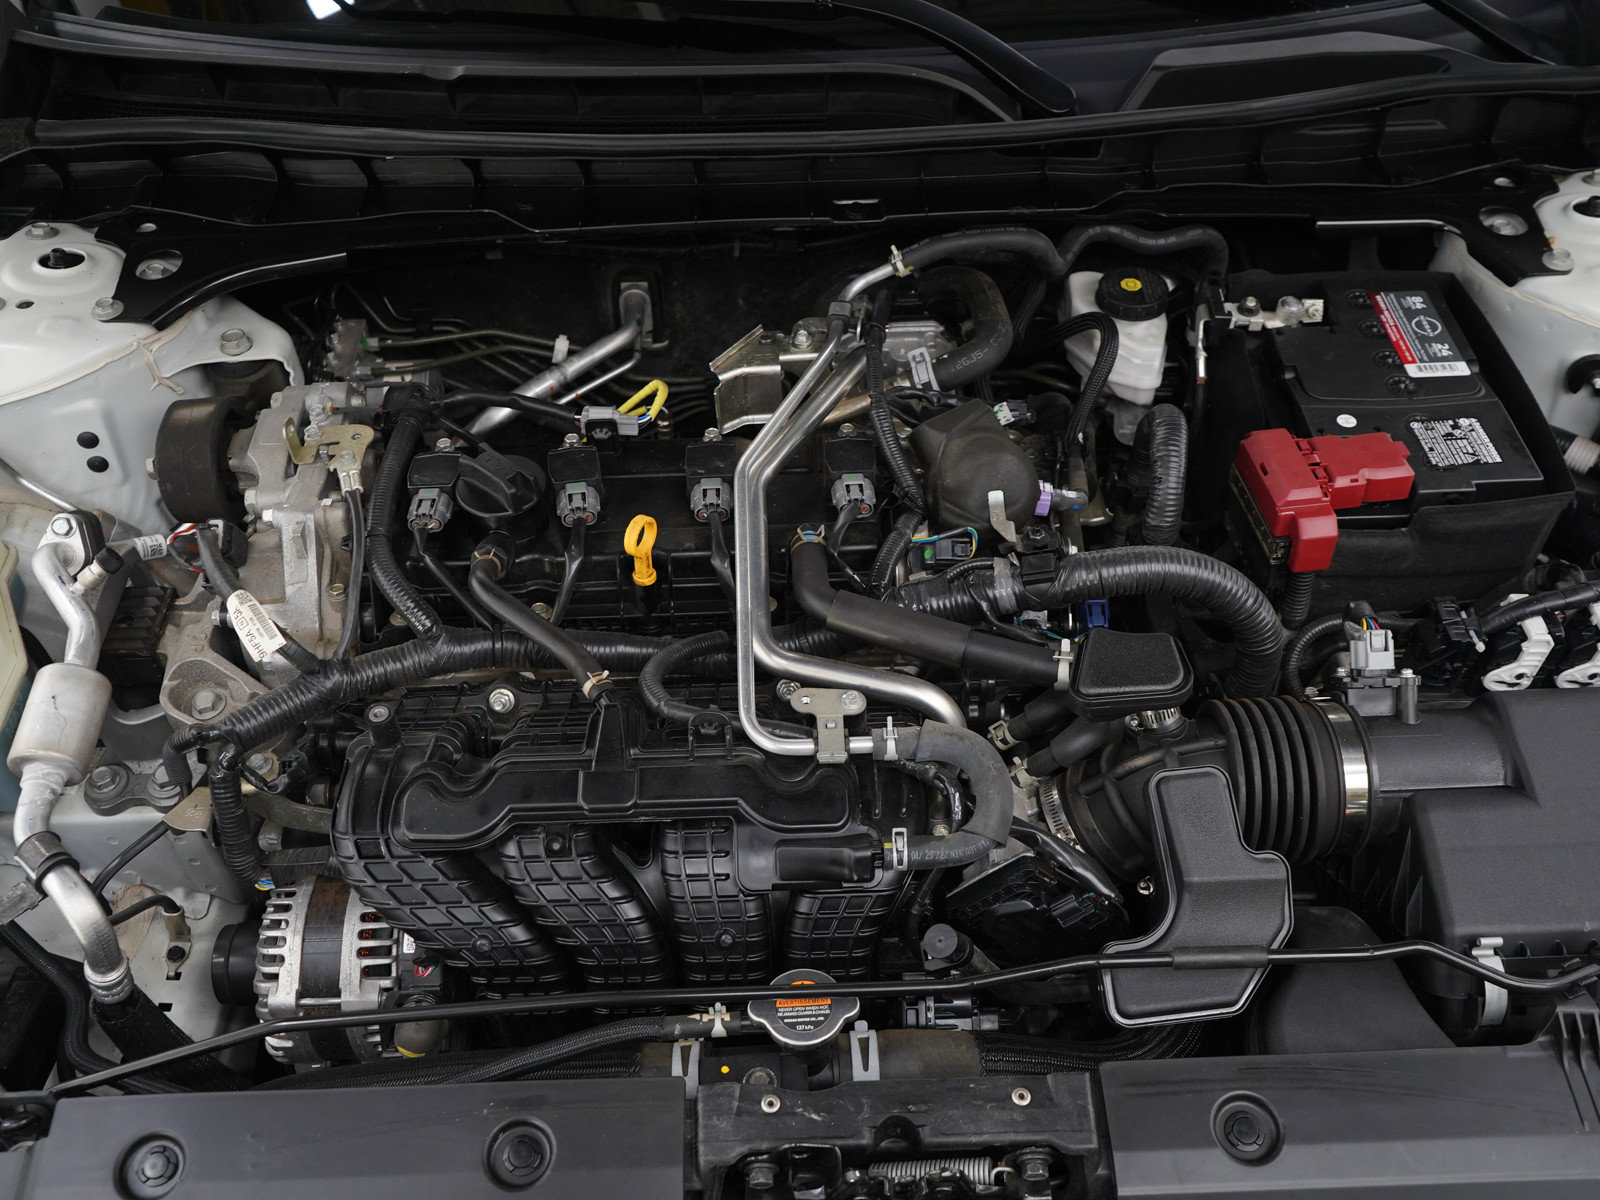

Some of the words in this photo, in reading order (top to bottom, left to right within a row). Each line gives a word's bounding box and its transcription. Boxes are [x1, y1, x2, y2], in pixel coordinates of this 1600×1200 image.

[1411, 296, 1427, 310] 84
[1419, 315, 1435, 337] NISSAN
[1438, 343, 1454, 357] 24
[245, 629, 267, 658] 9HF5A
